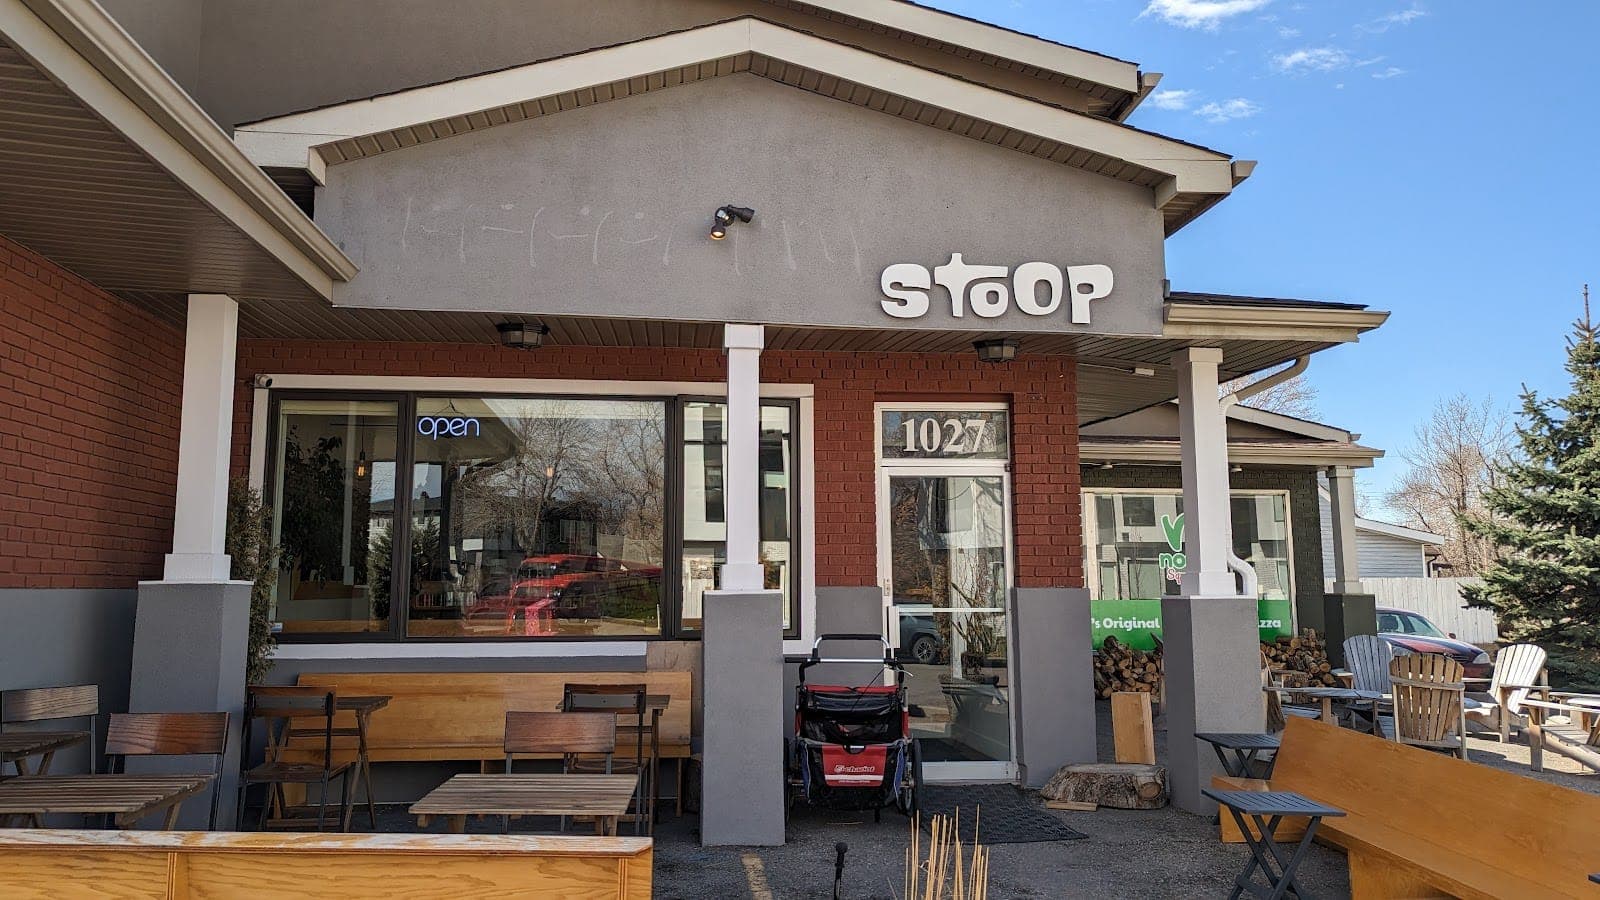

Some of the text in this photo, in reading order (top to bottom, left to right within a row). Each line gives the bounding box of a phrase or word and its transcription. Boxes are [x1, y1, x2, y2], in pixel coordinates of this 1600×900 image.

[417, 416, 480, 440] open
[901, 417, 987, 453] 1027
[1103, 616, 1160, 632] Original
[1258, 619, 1282, 628] zza
